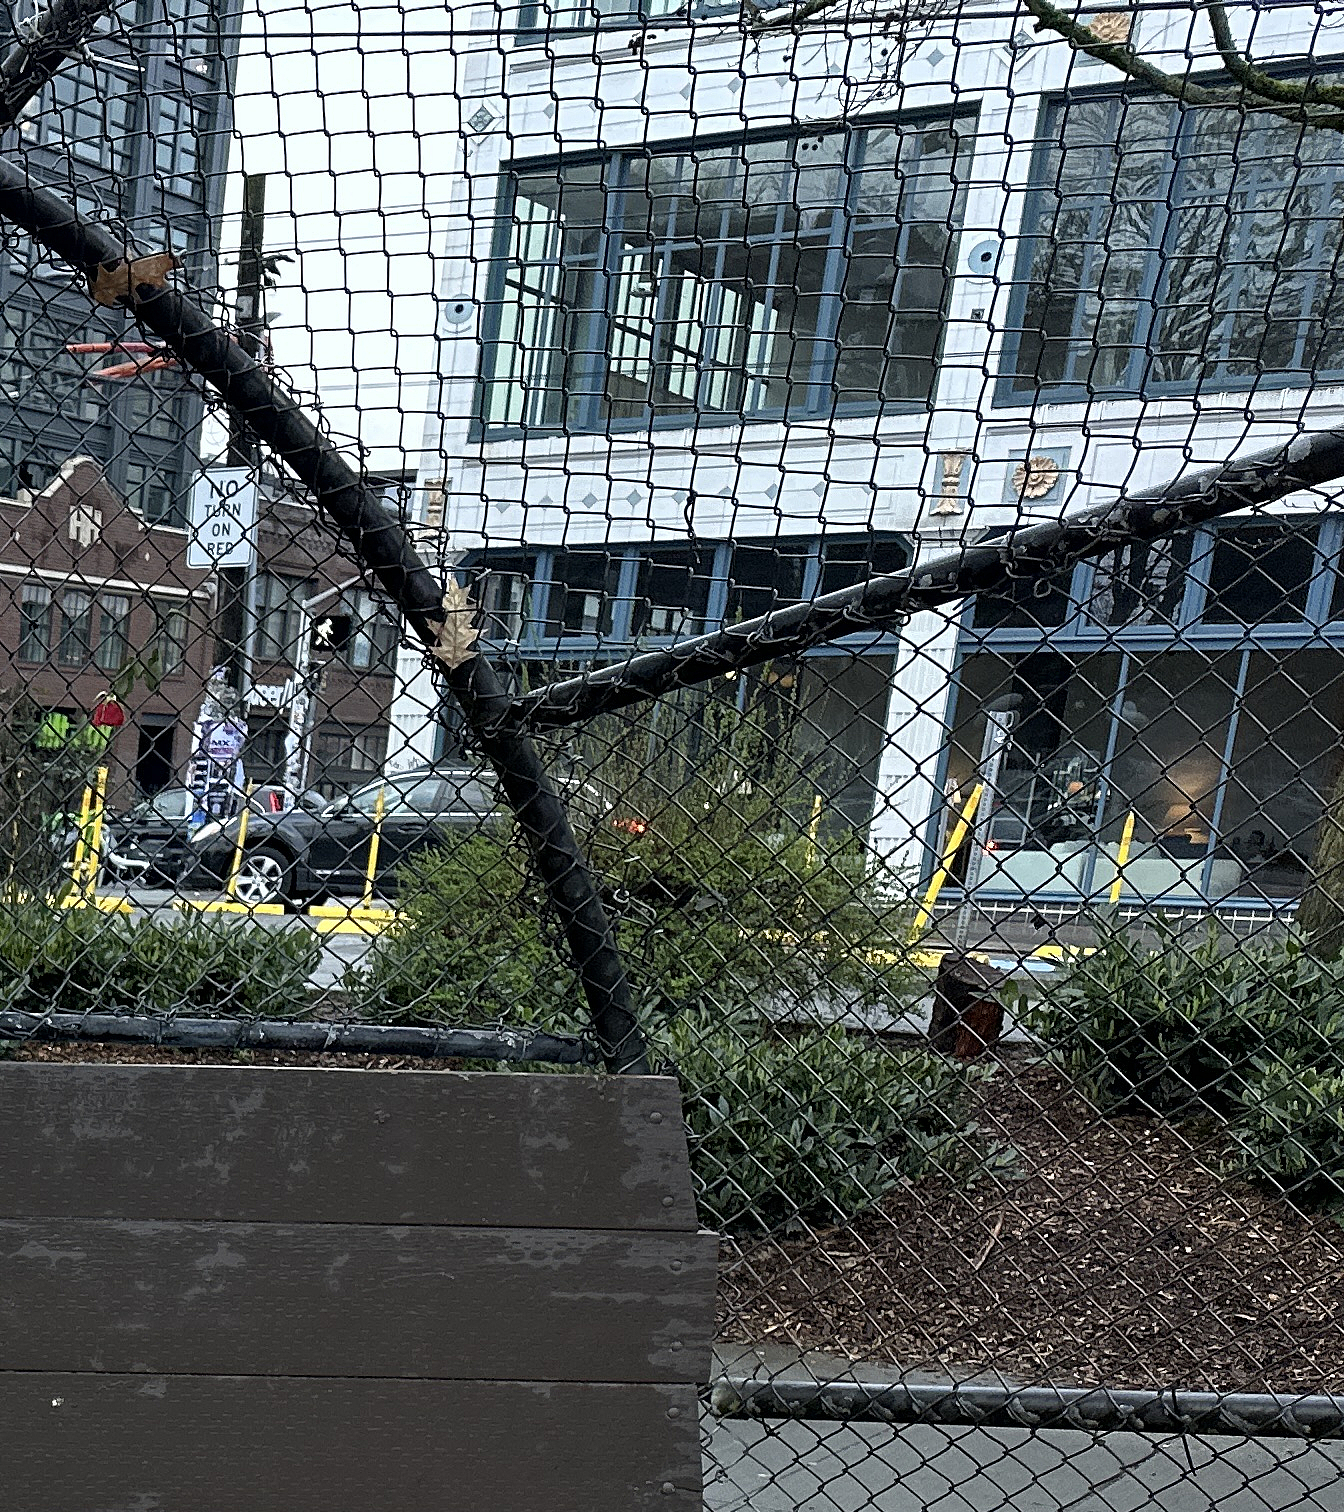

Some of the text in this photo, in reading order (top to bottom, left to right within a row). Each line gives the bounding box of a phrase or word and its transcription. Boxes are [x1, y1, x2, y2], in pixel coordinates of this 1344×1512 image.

[210, 479, 239, 499] NO
[204, 503, 242, 518] TURN
[212, 522, 231, 537] ON
[207, 541, 234, 556] RED
